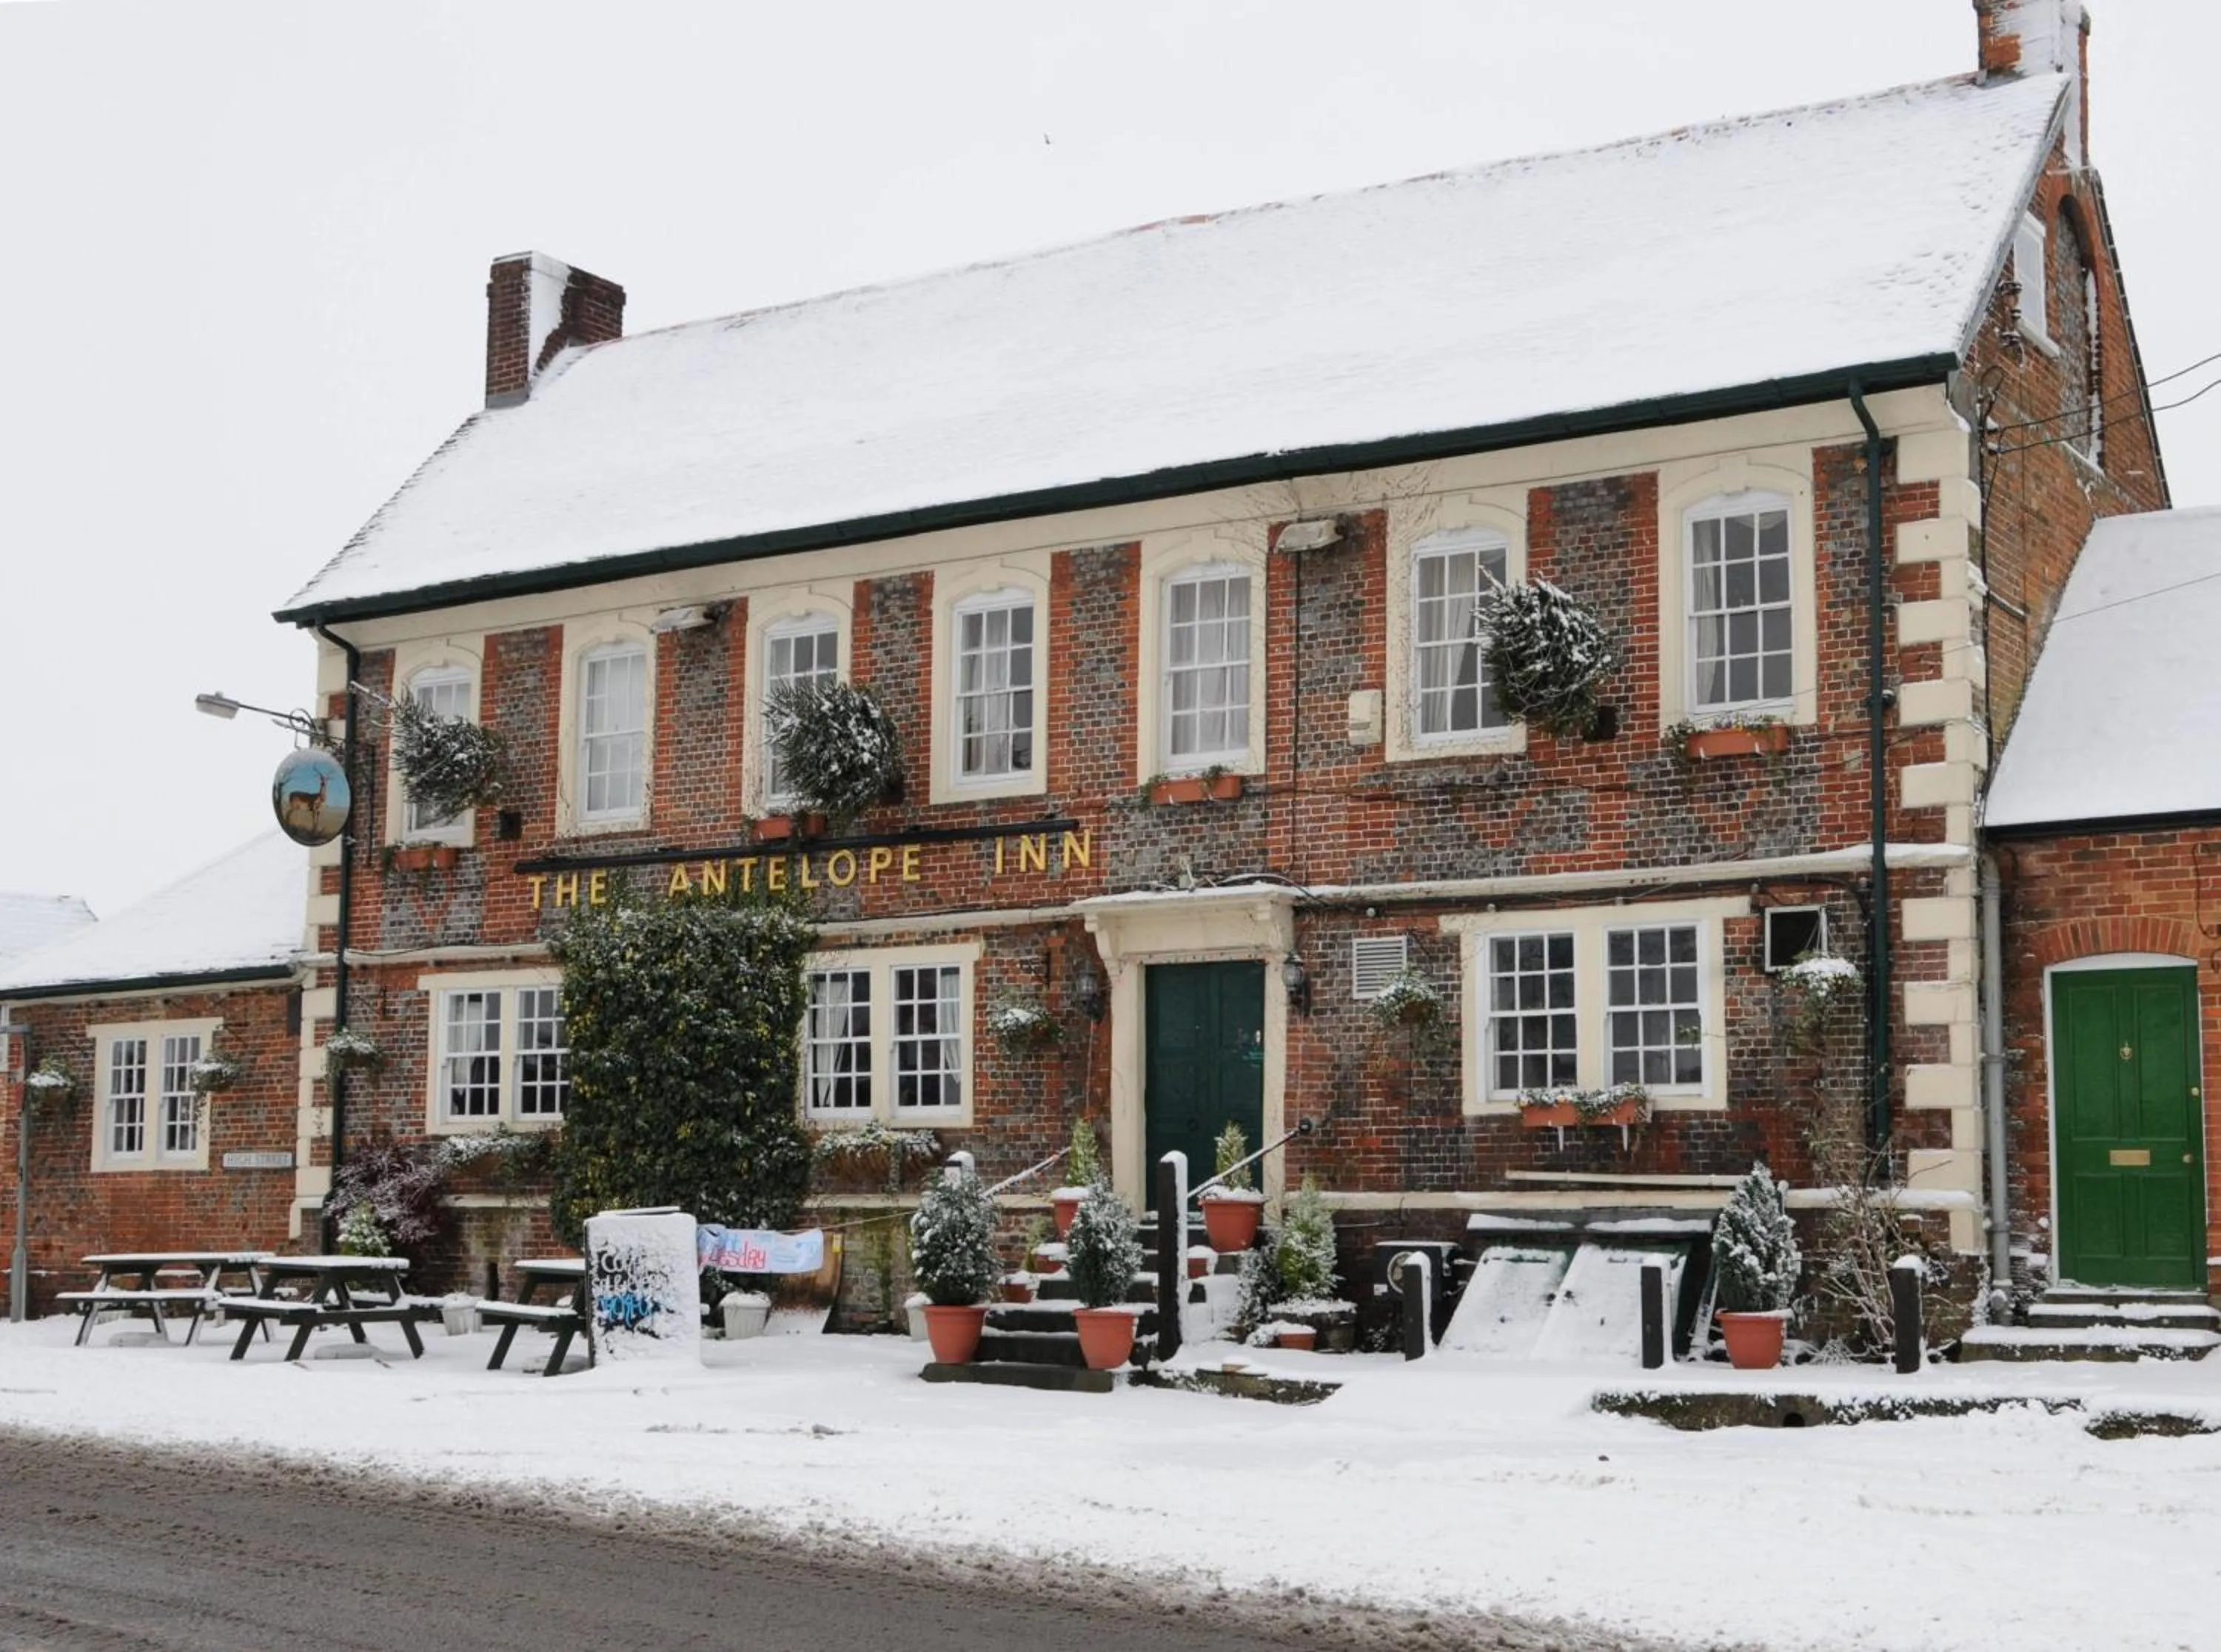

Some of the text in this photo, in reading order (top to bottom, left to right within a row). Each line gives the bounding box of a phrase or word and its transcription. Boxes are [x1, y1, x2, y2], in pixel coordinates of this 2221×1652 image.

[528, 828, 1091, 909] THE ANTELOPE INN
